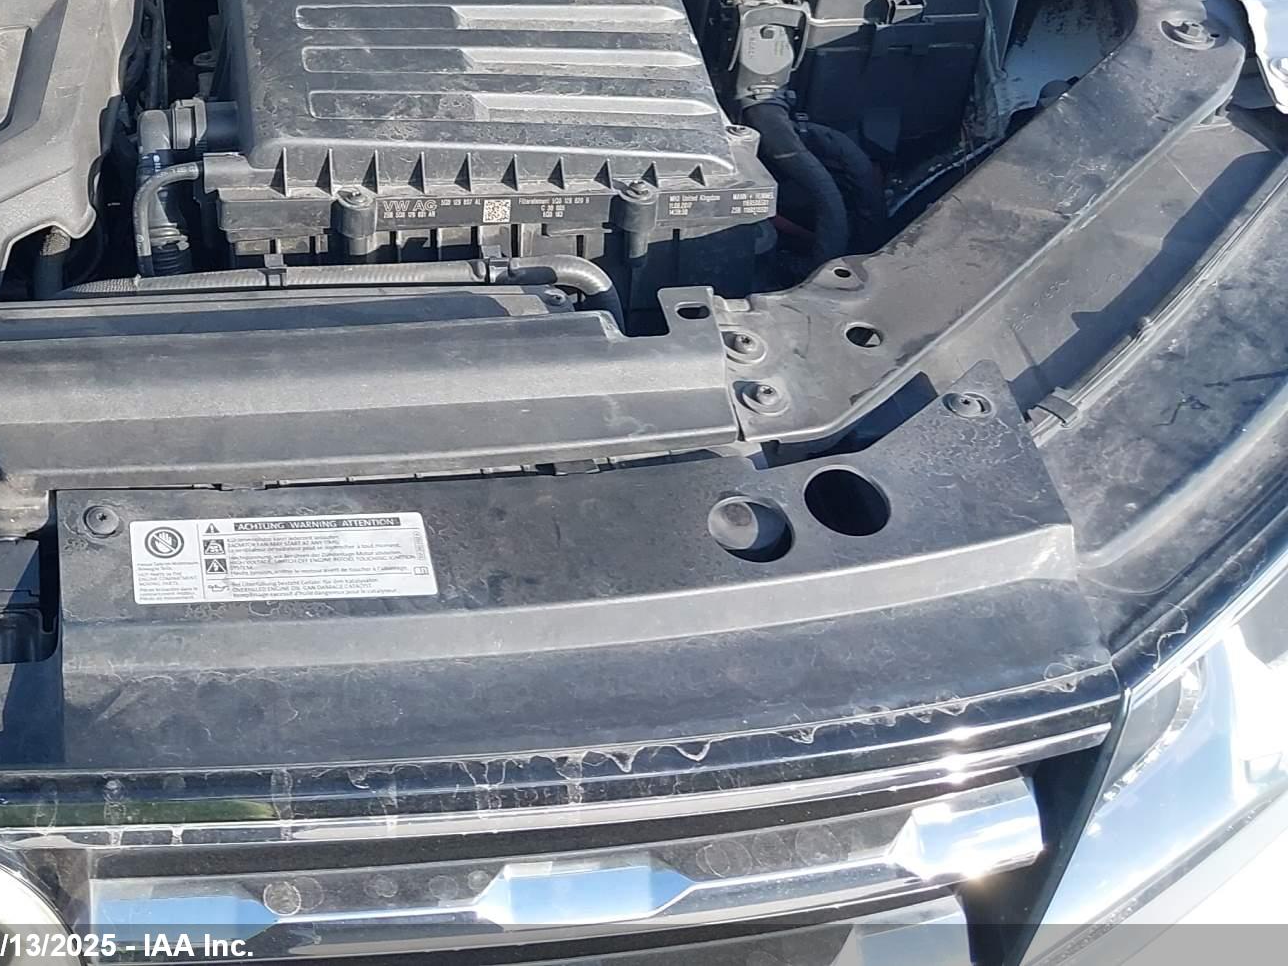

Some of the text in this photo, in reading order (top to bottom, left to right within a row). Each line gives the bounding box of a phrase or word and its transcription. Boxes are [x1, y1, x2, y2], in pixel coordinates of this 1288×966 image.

[383, 199, 438, 212] VW AG
[237, 518, 395, 531] ACHTUNG WARNING ATTENTION
